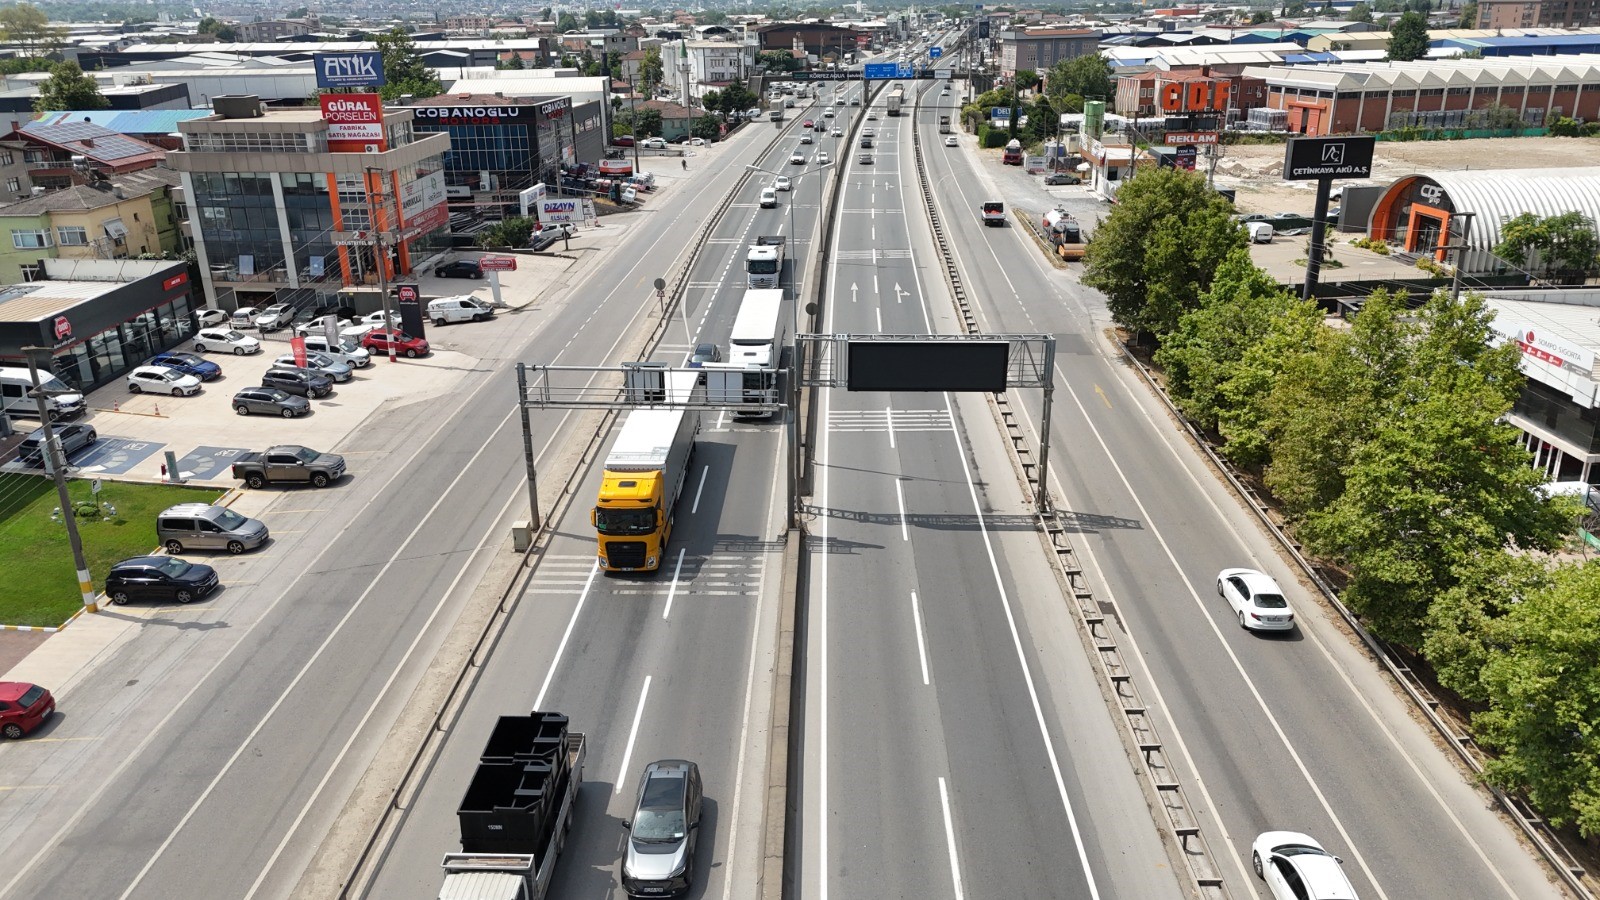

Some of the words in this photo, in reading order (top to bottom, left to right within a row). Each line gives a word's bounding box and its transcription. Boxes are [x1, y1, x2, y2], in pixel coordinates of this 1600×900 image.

[328, 99, 371, 111] GÜRAL
[325, 111, 377, 121] PORSELEN
[1167, 134, 1217, 143] REKLAM
[1293, 166, 1334, 176] ÇETİNKAYA
[1336, 165, 1352, 173] AKÜ
[1538, 338, 1557, 351] SOMPO
